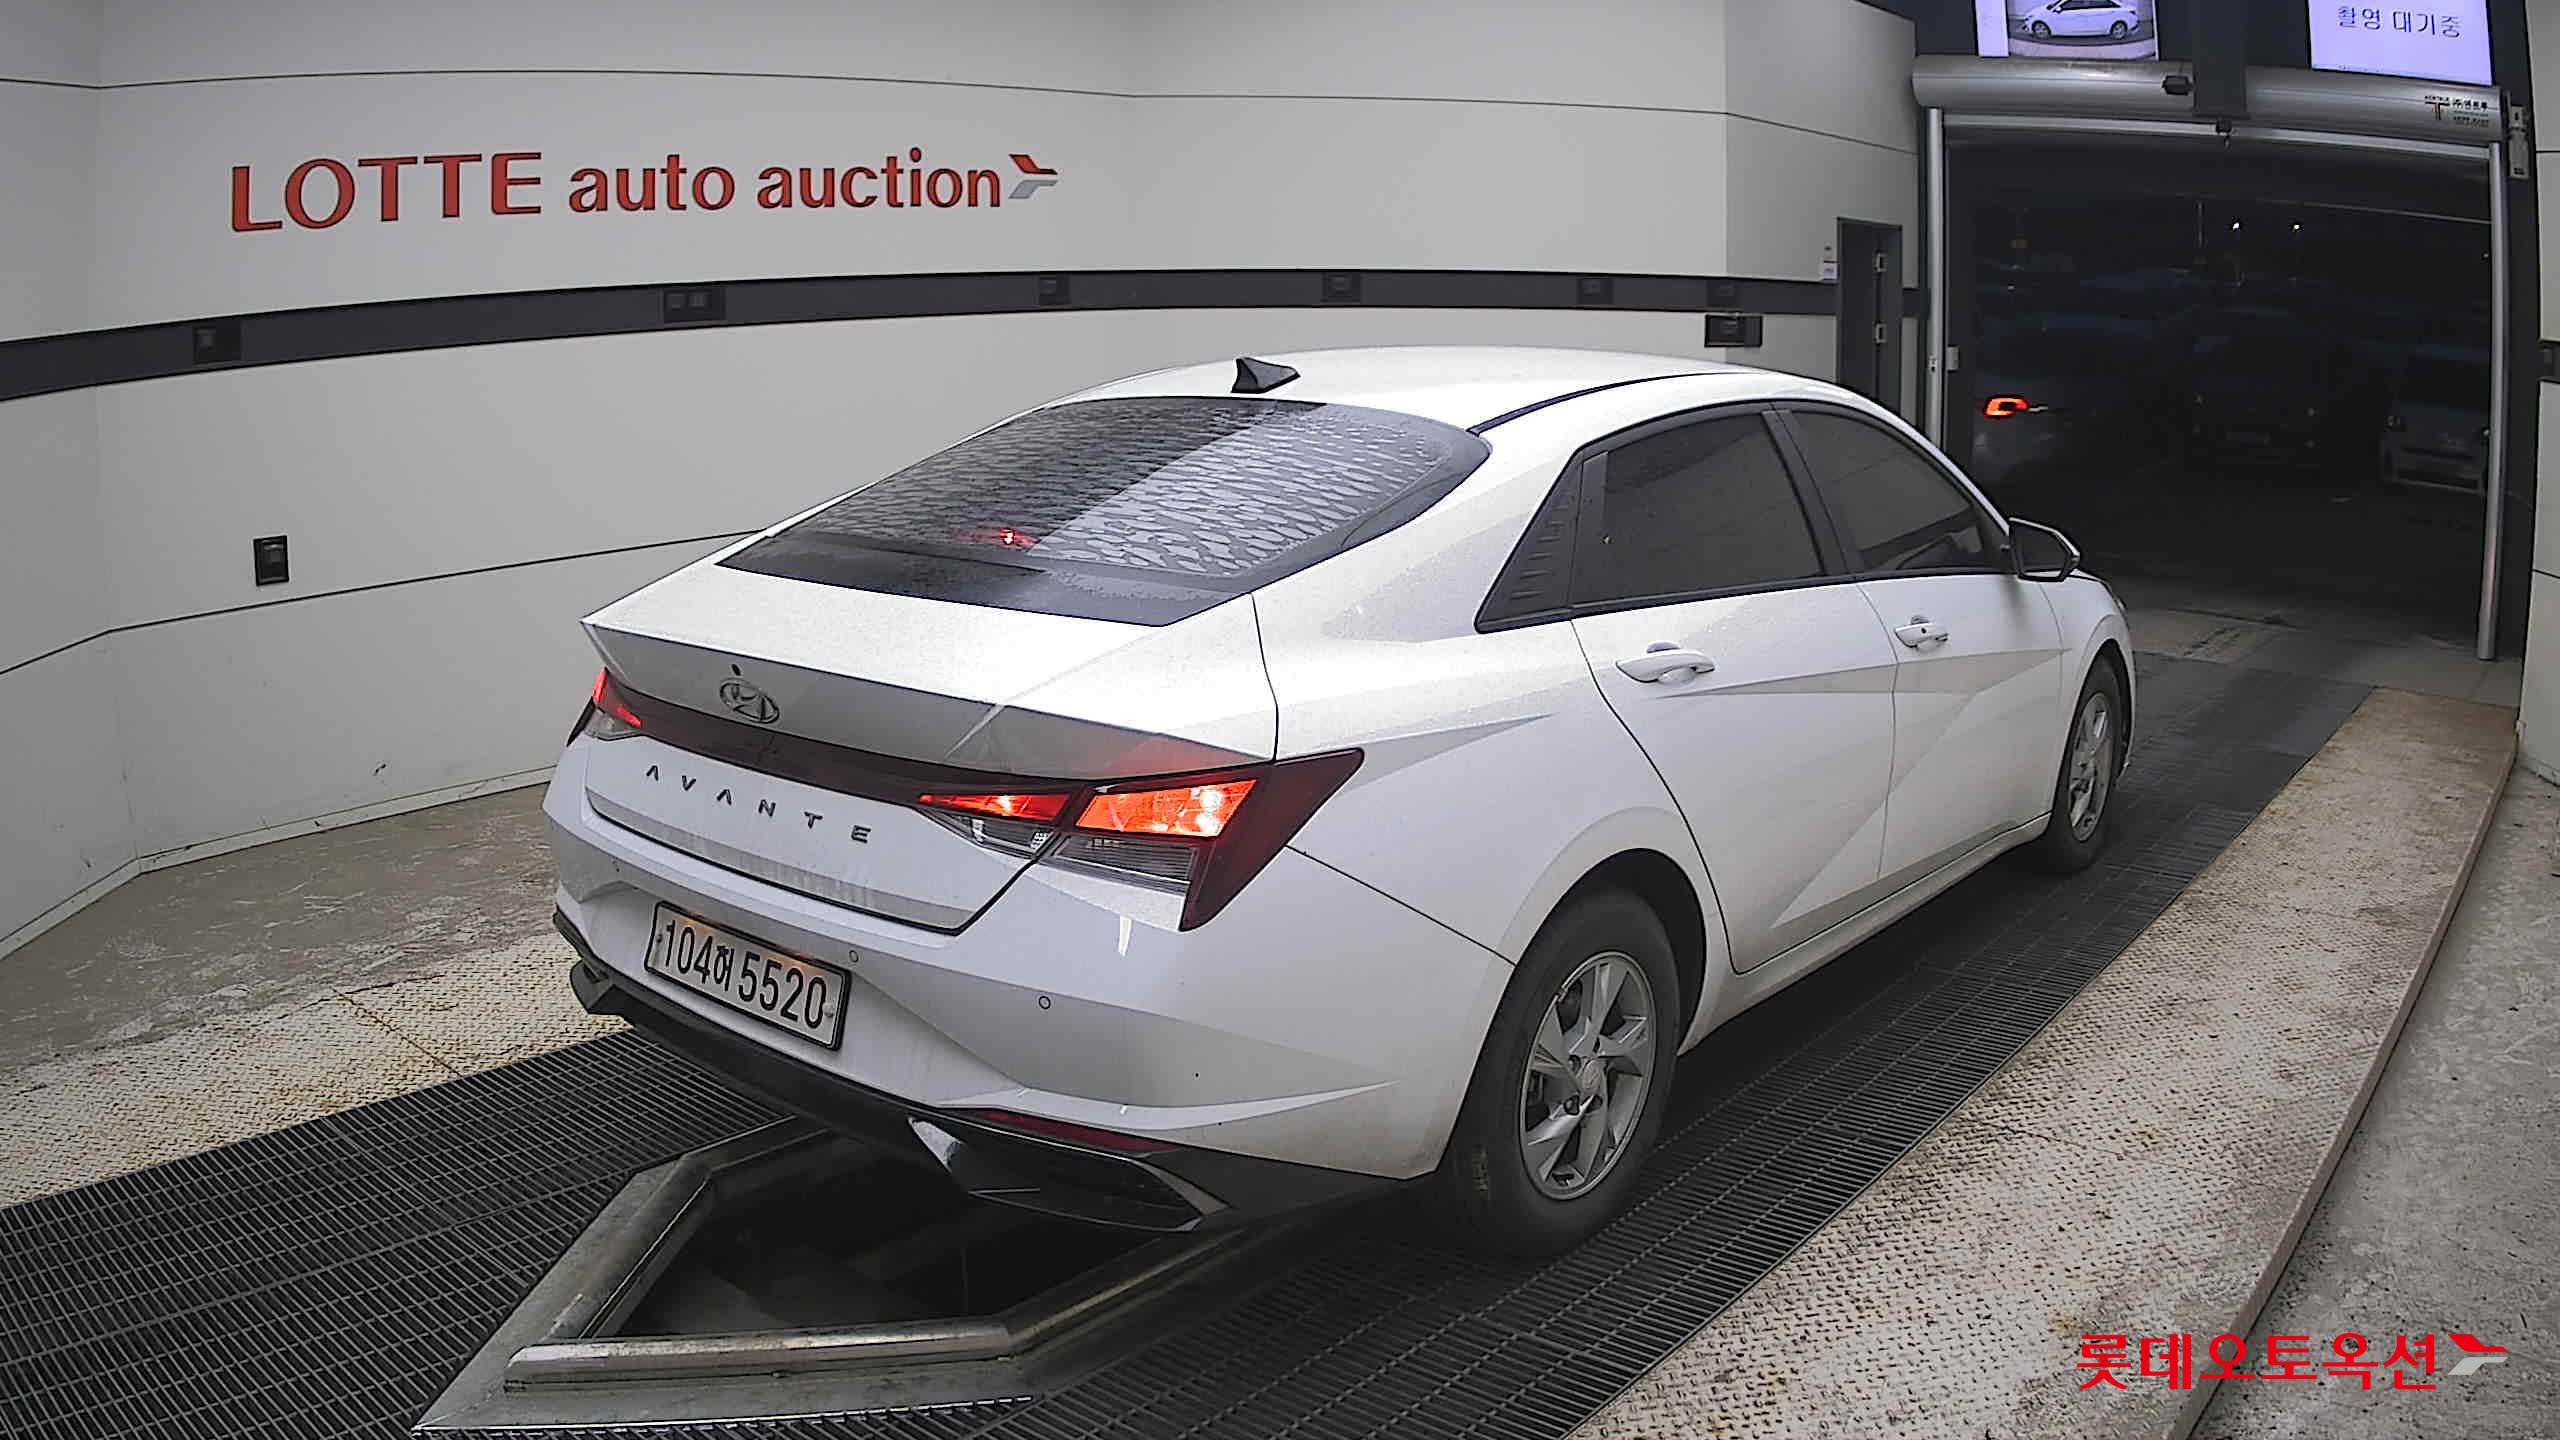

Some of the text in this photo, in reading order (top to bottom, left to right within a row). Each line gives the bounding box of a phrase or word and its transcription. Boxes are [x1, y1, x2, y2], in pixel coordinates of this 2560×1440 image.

[2392, 11, 2460, 38] 대기중
[231, 147, 1003, 233] LOTTE auto auction
[645, 764, 872, 843] AVANTE
[737, 950, 828, 1030] 5520
